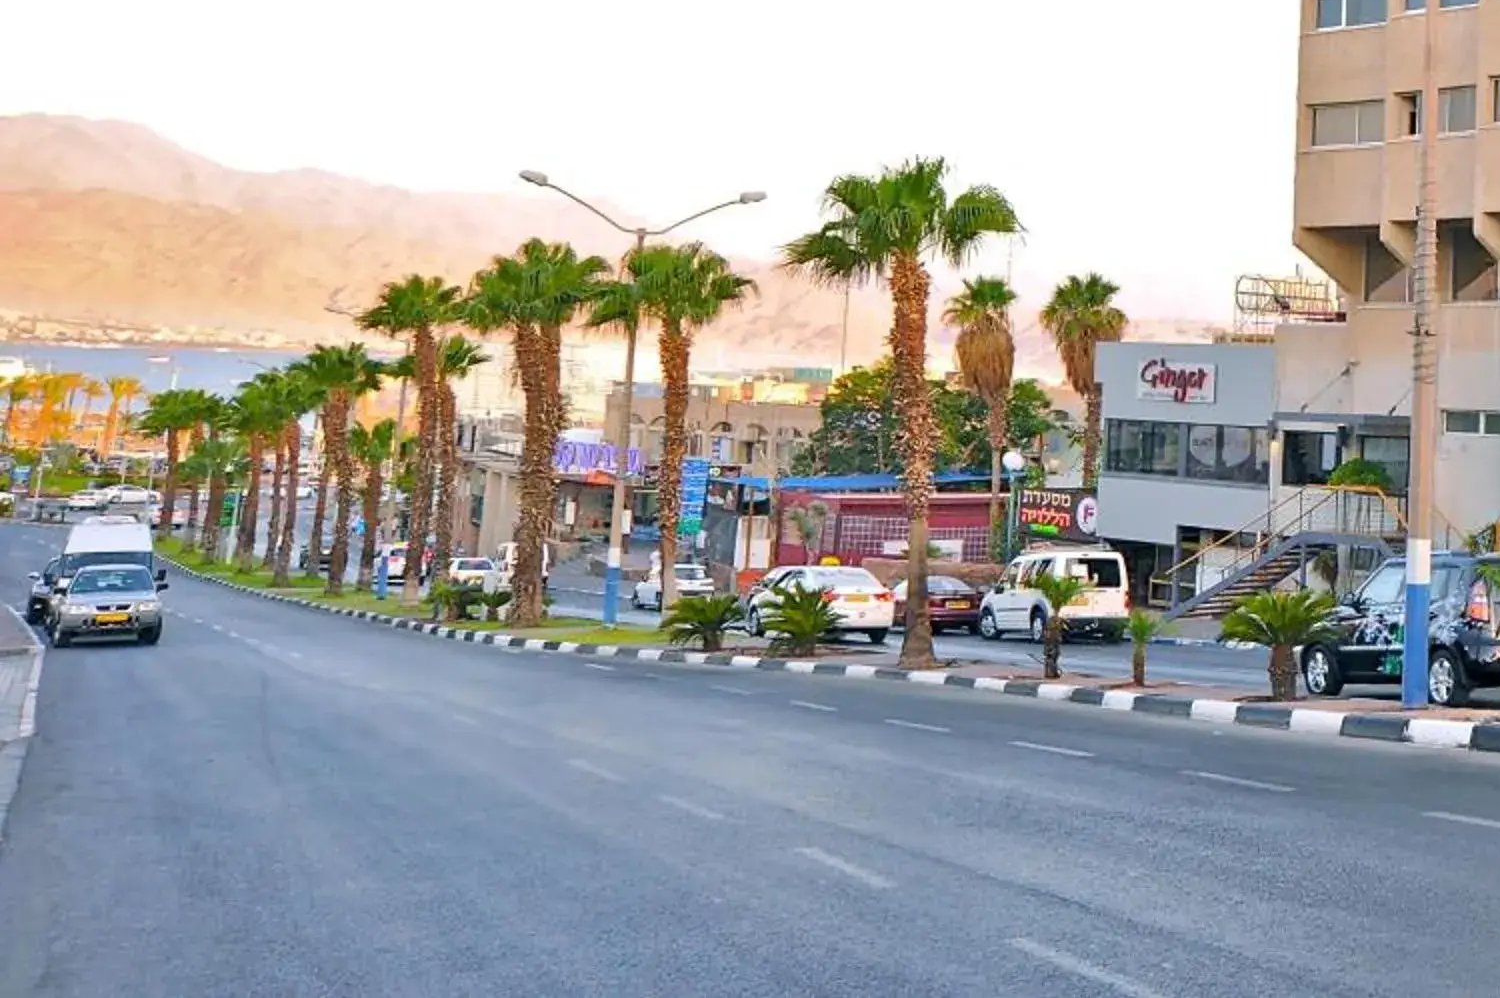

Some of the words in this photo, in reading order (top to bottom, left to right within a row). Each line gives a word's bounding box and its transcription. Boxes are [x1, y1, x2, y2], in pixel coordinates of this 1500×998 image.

[1141, 358, 1207, 402] Ginger
[1022, 489, 1071, 507] מסעדת
[1021, 507, 1071, 527] הללויה
